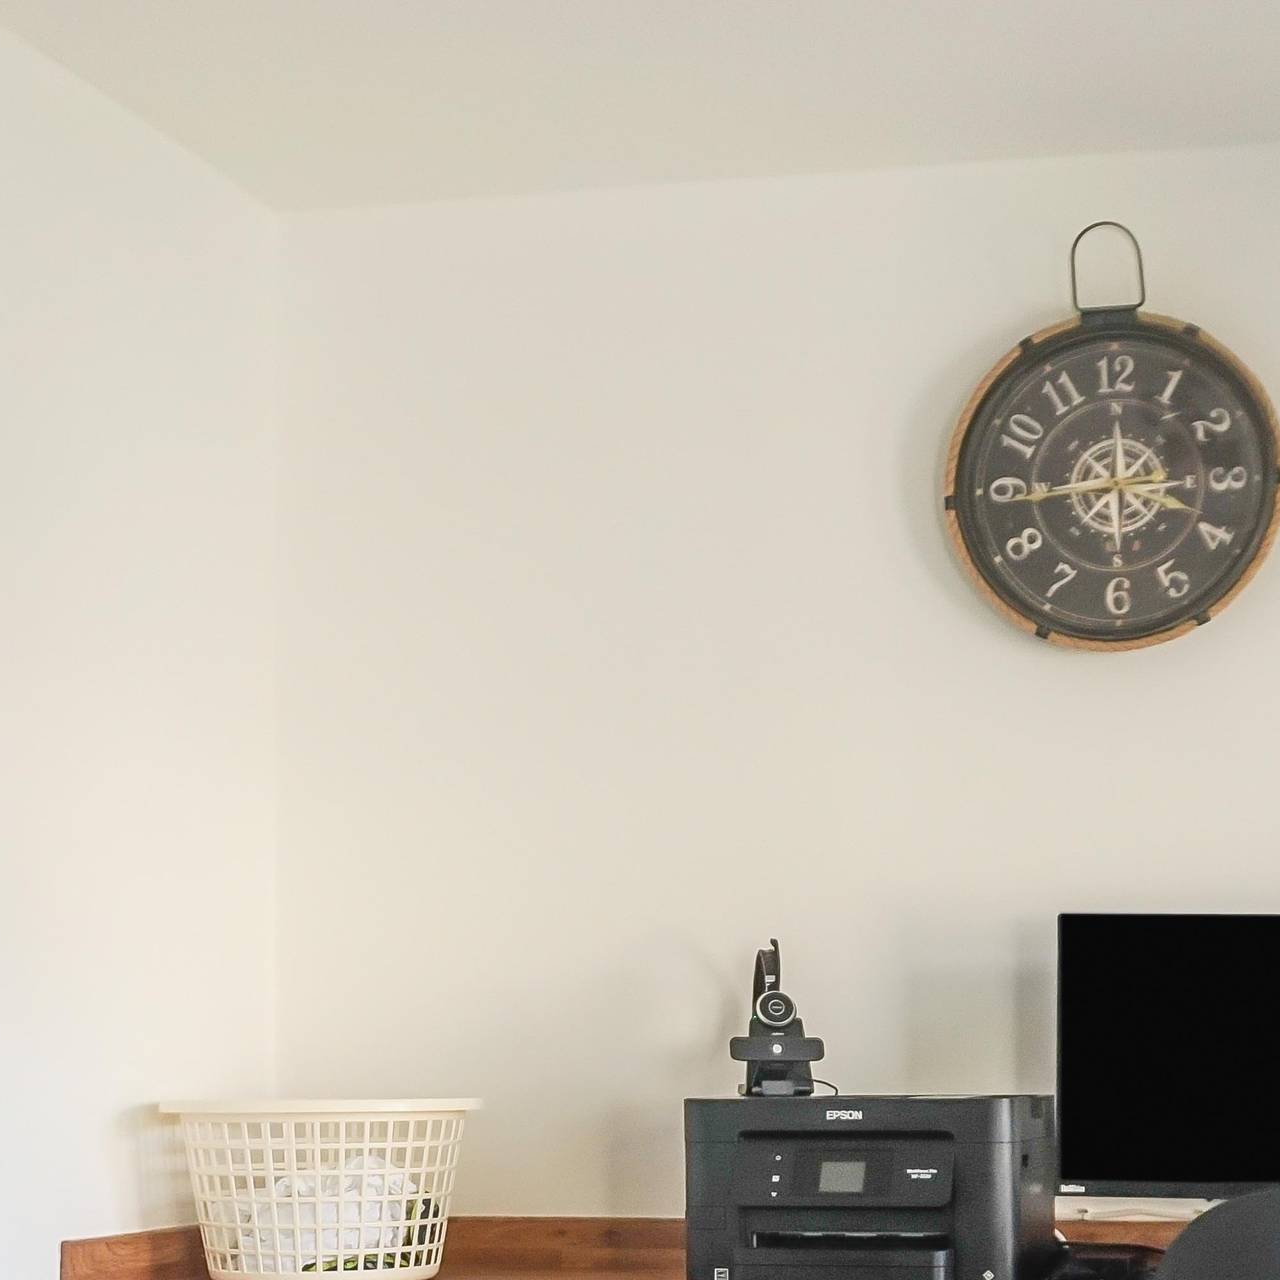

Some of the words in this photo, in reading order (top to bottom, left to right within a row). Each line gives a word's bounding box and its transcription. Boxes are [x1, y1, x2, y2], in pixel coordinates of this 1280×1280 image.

[1095, 355, 1136, 394] 12
[1154, 370, 1184, 405] 1
[1041, 371, 1086, 416] 11
[1001, 413, 1044, 459] 10
[1191, 408, 1232, 443] 2
[989, 476, 1028, 503] 9
[1184, 475, 1197, 489] E
[1209, 466, 1248, 492] 3
[1006, 527, 1043, 561] 8
[1197, 521, 1236, 551] 4
[1045, 561, 1078, 599] 7
[1105, 576, 1132, 615] 6
[1156, 559, 1191, 598] 5
[826, 1110, 863, 1120] EPSON
